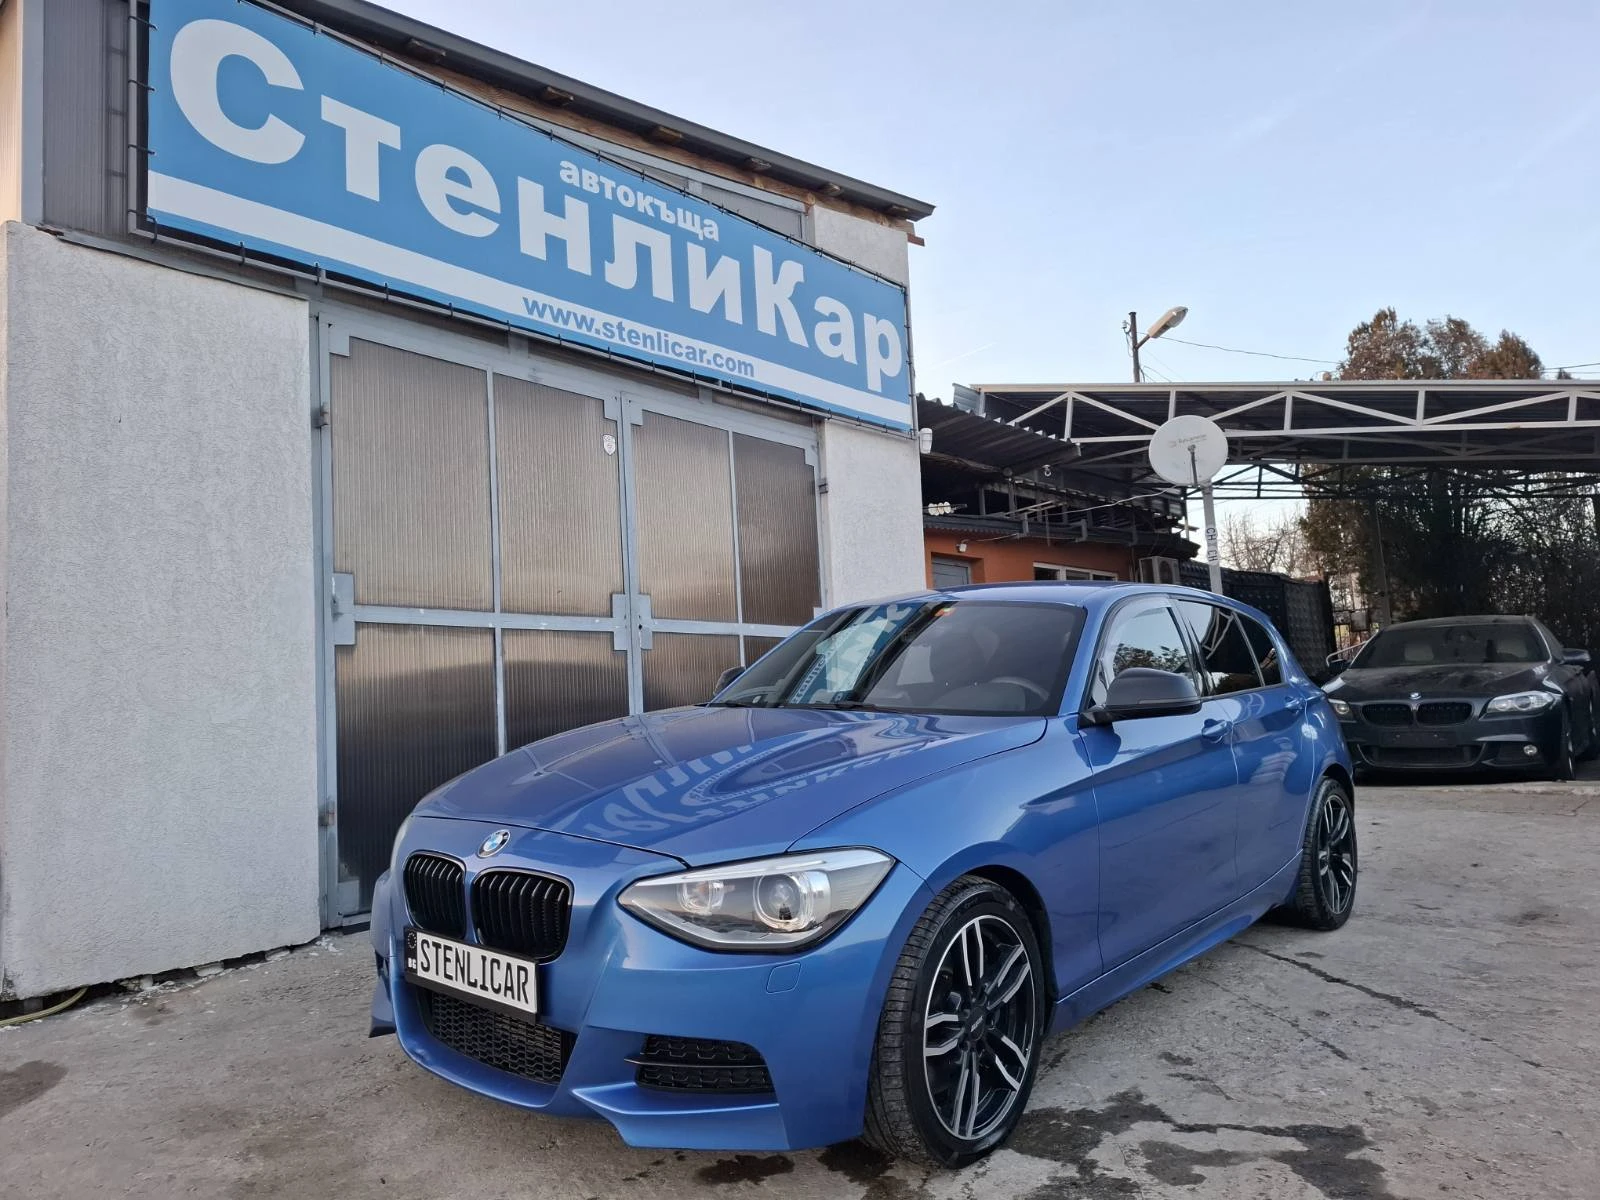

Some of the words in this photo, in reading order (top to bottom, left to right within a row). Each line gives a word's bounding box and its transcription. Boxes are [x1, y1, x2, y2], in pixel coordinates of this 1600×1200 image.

[170, 18, 902, 392] СтенлиКар
[560, 160, 719, 242] автокъща
[523, 297, 754, 378] www.stenlicar.com
[420, 939, 528, 1004] STENLICAR
